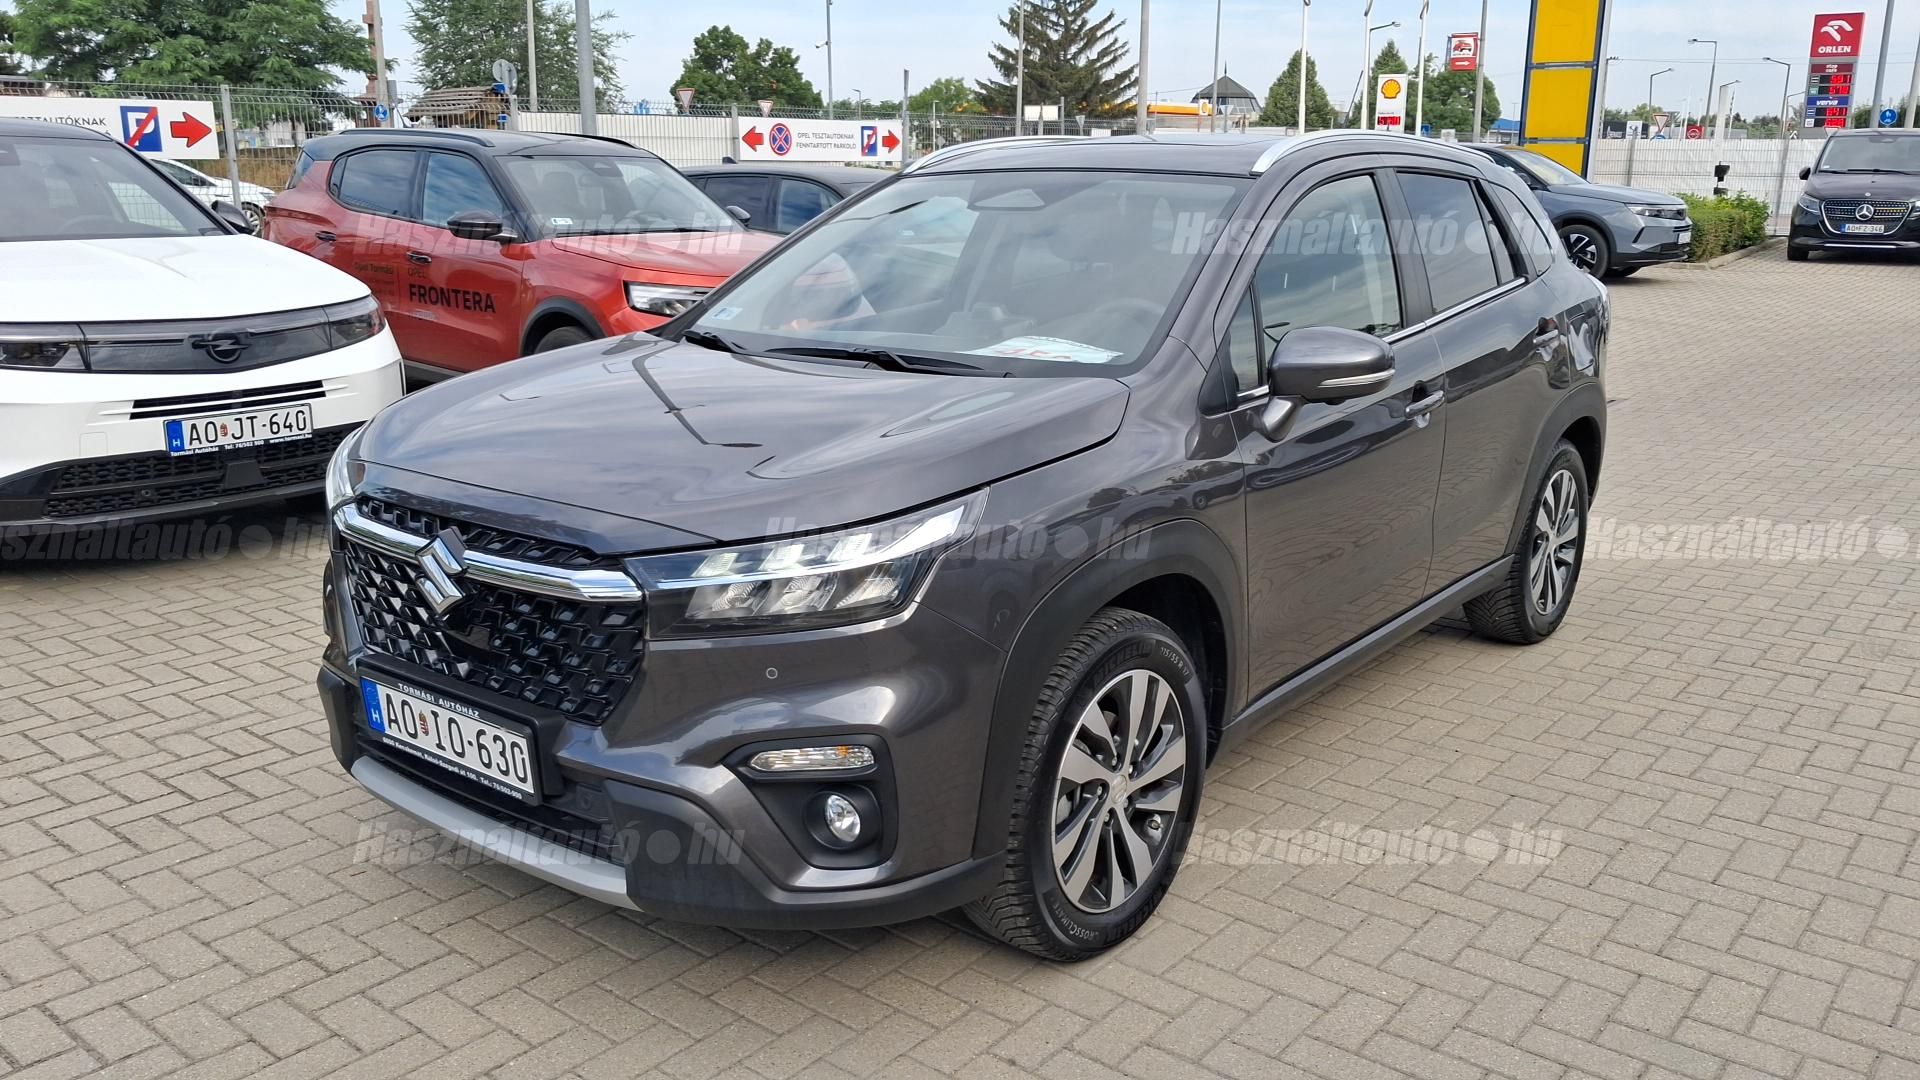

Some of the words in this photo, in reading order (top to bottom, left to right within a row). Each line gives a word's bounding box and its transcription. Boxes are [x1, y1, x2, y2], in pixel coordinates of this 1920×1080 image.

[1818, 45, 1851, 53] ORLEN
[15, 115, 107, 126] TAUTÓKNAK
[408, 266, 426, 279] OPEL
[408, 283, 496, 314] FRONTERA
[189, 420, 219, 446] AO
[231, 409, 307, 440] JT-640
[172, 438, 181, 447] H
[397, 682, 437, 705] TORMÁSI
[438, 698, 481, 719] AUTÓHÁZ
[371, 709, 381, 725] H
[385, 692, 419, 740] AO
[430, 709, 528, 784] IO-630
